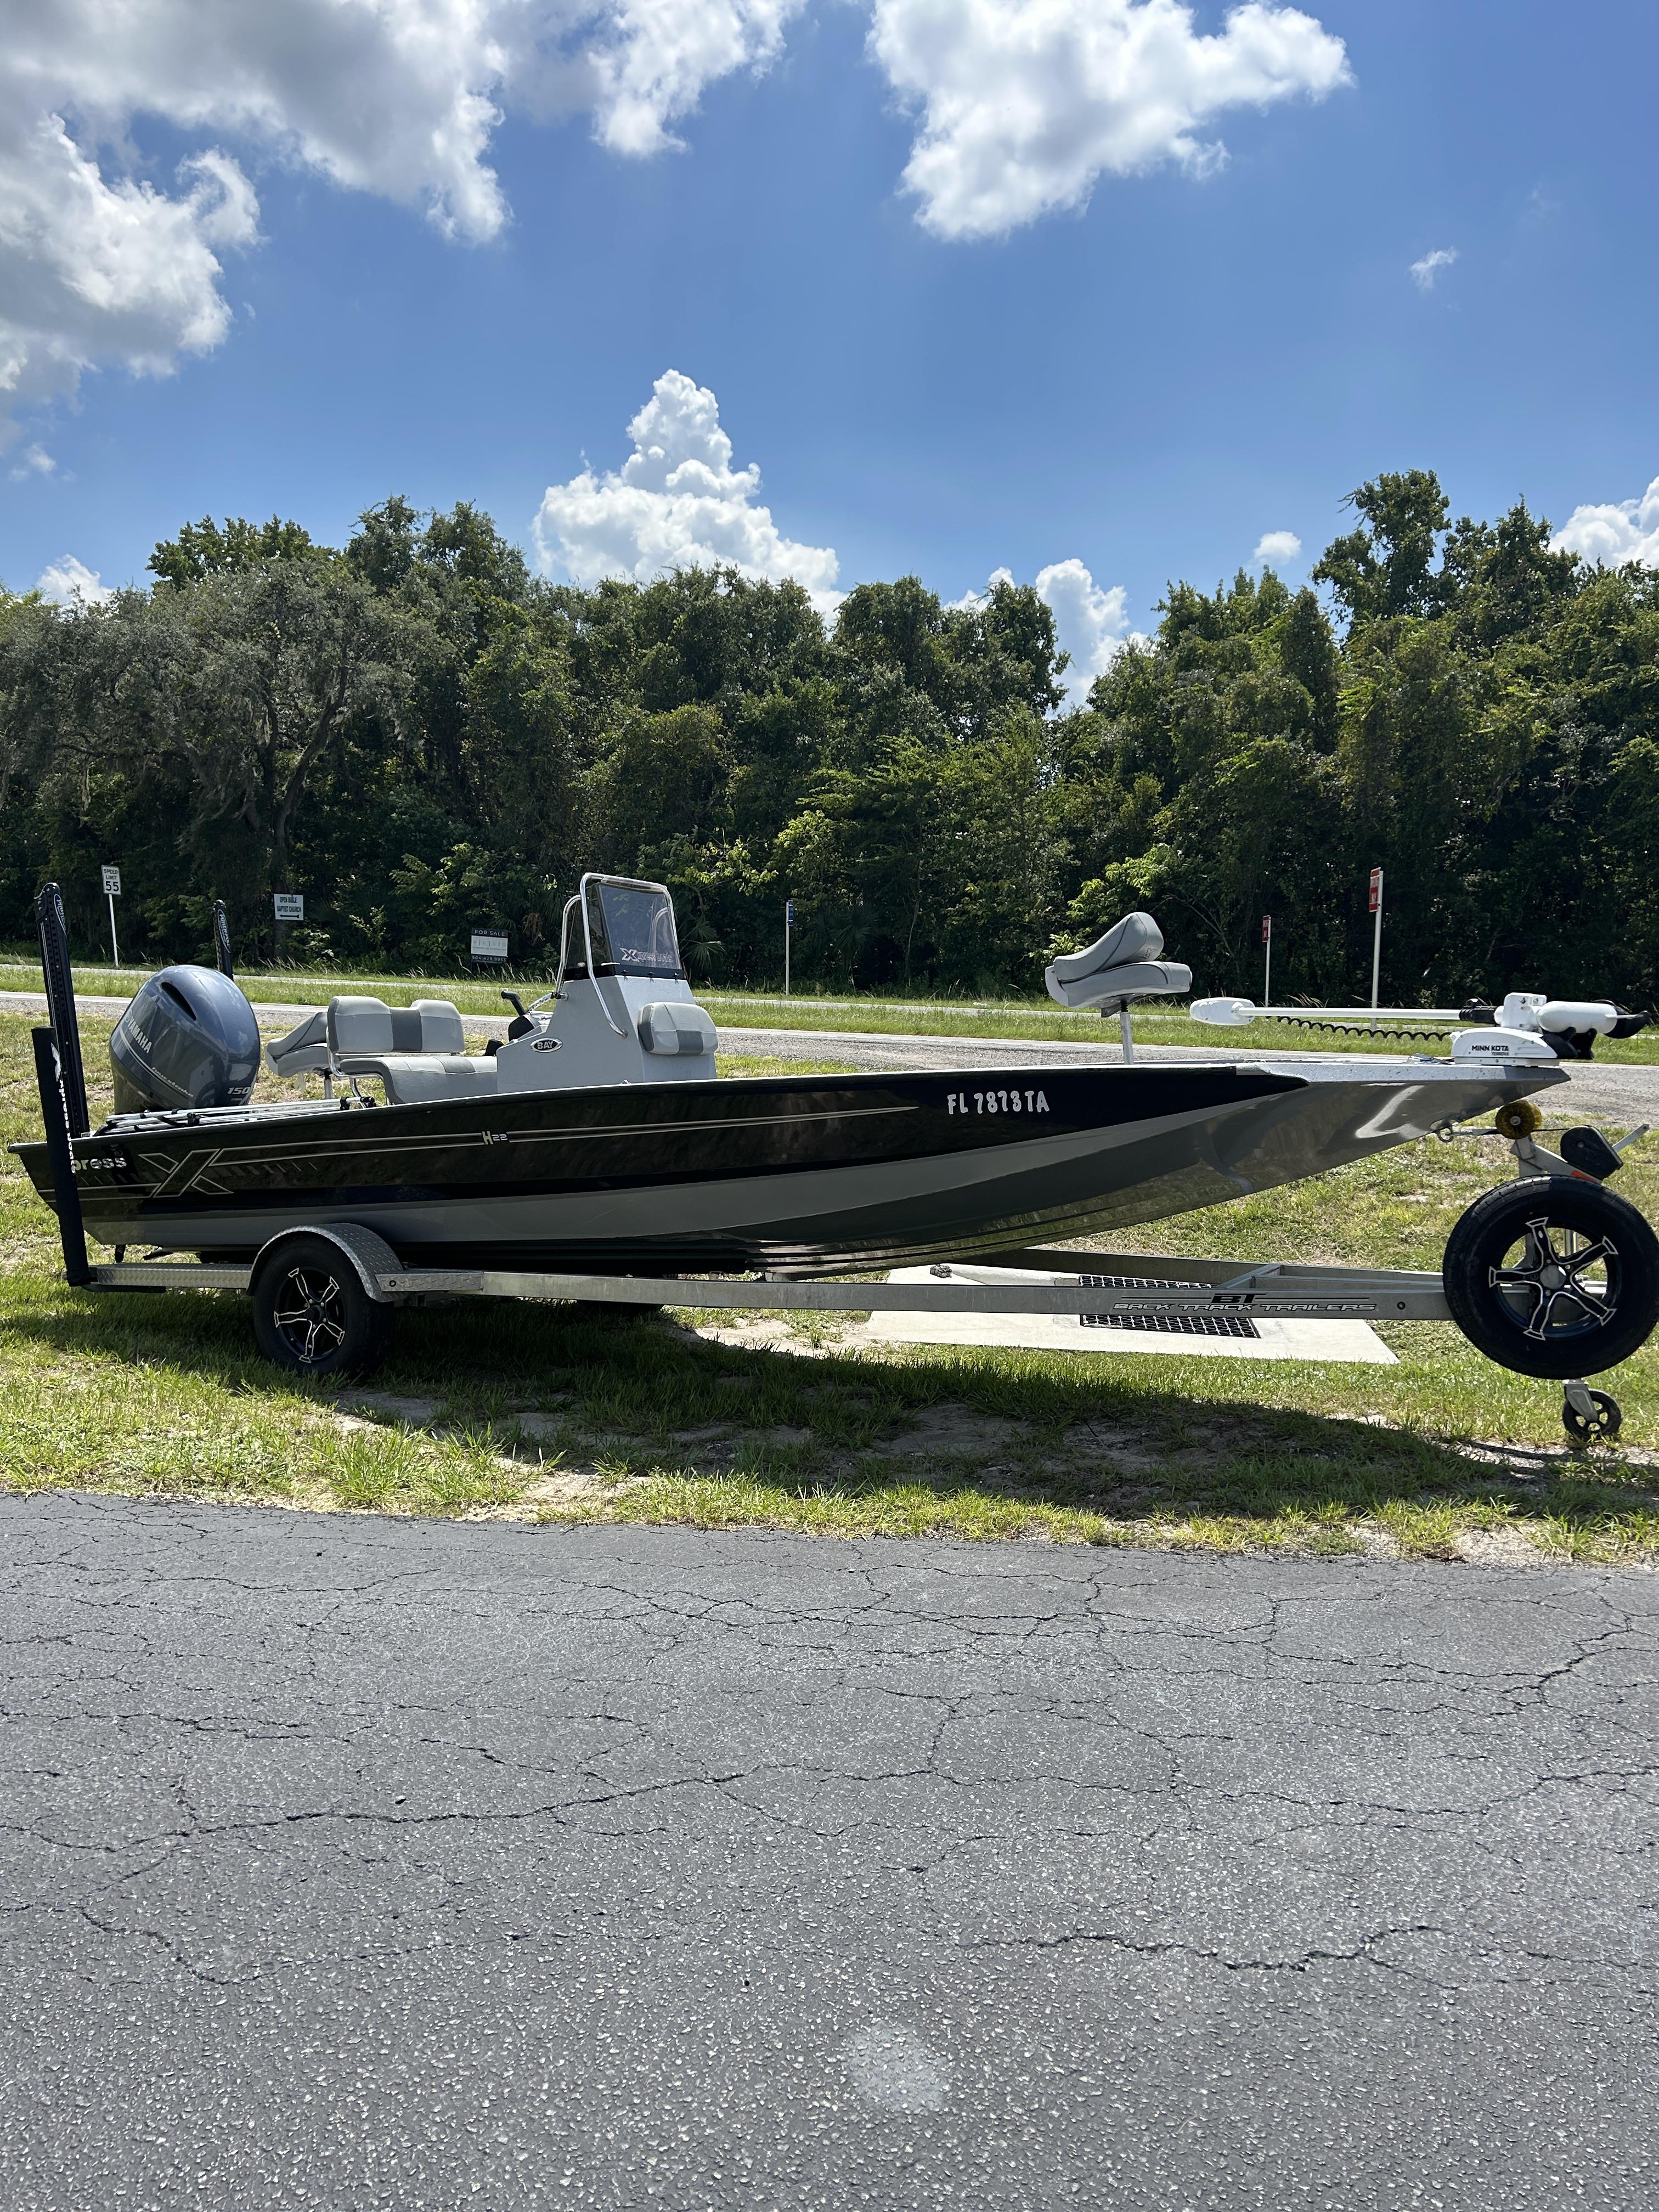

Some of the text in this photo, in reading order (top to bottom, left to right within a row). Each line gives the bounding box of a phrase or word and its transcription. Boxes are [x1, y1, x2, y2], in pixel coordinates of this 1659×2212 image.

[106, 881, 119, 891] 55
[127, 1017, 153, 1054] YAMAHA
[947, 1091, 1049, 1114] FL 7873 TA
[74, 1157, 127, 1171] press
[1211, 1294, 1266, 1303] BT
